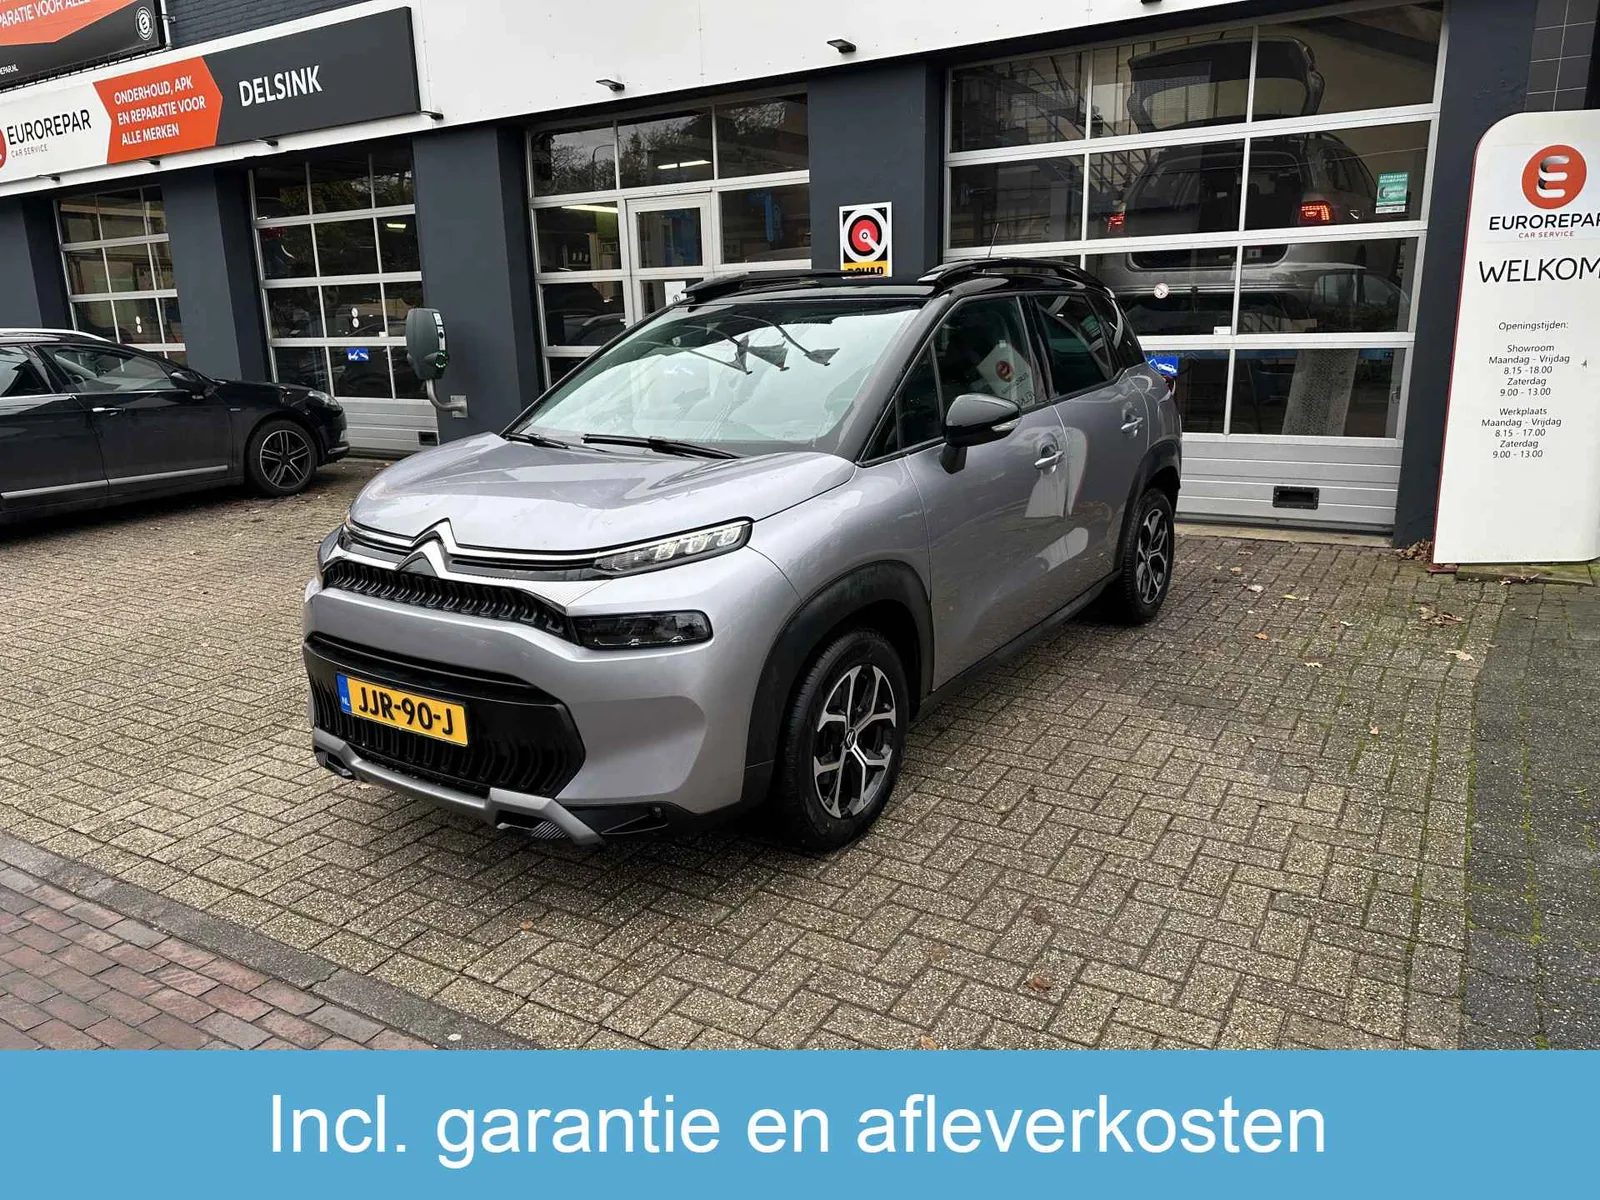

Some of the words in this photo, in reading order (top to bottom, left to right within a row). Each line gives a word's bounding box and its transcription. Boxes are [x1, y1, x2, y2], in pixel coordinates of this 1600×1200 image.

[33, 0, 66, 15] VOOR
[114, 80, 173, 105] ONDERHOUD,
[174, 75, 193, 92] APK
[238, 65, 323, 107] DELSINK
[117, 111, 130, 126] EN
[130, 101, 177, 124] REPARATIE
[177, 95, 206, 113] VOOR
[6, 109, 92, 146] EUROREPAR
[121, 130, 142, 146] ALLE
[142, 122, 180, 141] MERKEN
[11, 149, 23, 158] CAR
[24, 144, 48, 155] SERVICE
[1518, 231, 1536, 239] CAR
[1538, 230, 1574, 238] SERVICE
[1478, 257, 1600, 283] WELKOM
[1498, 321, 1569, 331] Openingstijden:
[1507, 345, 1555, 353] Showroom
[1488, 356, 1530, 365] Maandag
[1539, 354, 1570, 364] Vrijdag
[1503, 366, 1522, 375] 8.15
[1507, 377, 1547, 386] Zaterdag
[1500, 388, 1518, 397] 9.00
[1528, 387, 1551, 396] 13.00
[1499, 408, 1547, 417] Werkplaats
[1481, 419, 1522, 428] Maandag
[1531, 418, 1562, 427] Vrijdag
[1495, 429, 1513, 437] 8.15
[1523, 428, 1546, 437] 17.00
[1500, 440, 1539, 449] Zaterdag
[1492, 450, 1511, 459] 9.00
[1520, 449, 1543, 458] 13.00
[358, 687, 454, 735] JJR-90-J
